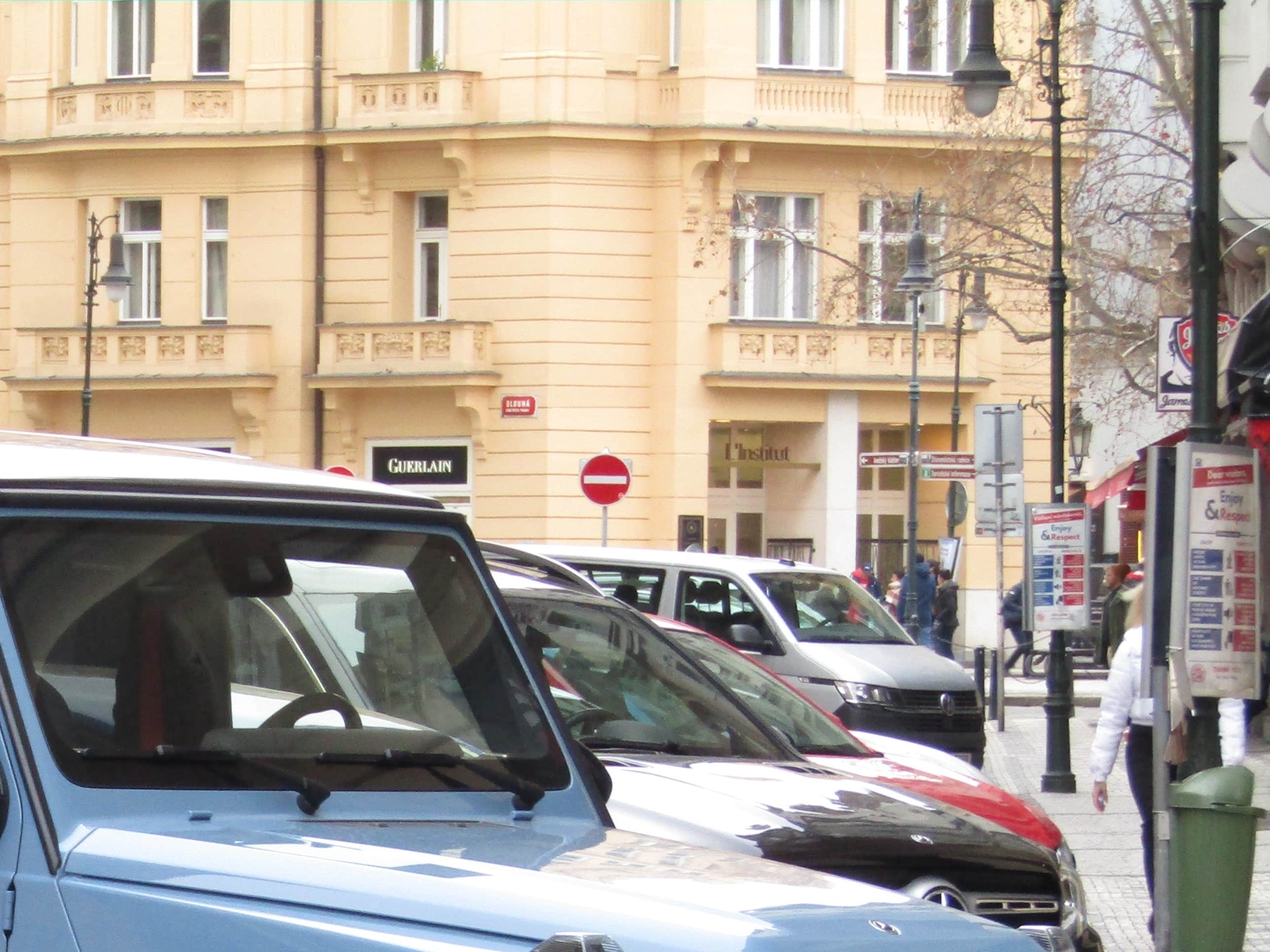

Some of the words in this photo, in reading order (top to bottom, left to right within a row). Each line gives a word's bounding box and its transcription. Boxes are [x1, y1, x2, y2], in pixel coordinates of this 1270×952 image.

[725, 443, 790, 462] L'Institut
[387, 458, 452, 473] GUERLAIN
[1220, 490, 1244, 507] Enjoy
[1051, 525, 1072, 533] Enjoy
[1051, 533, 1080, 541] Respect
